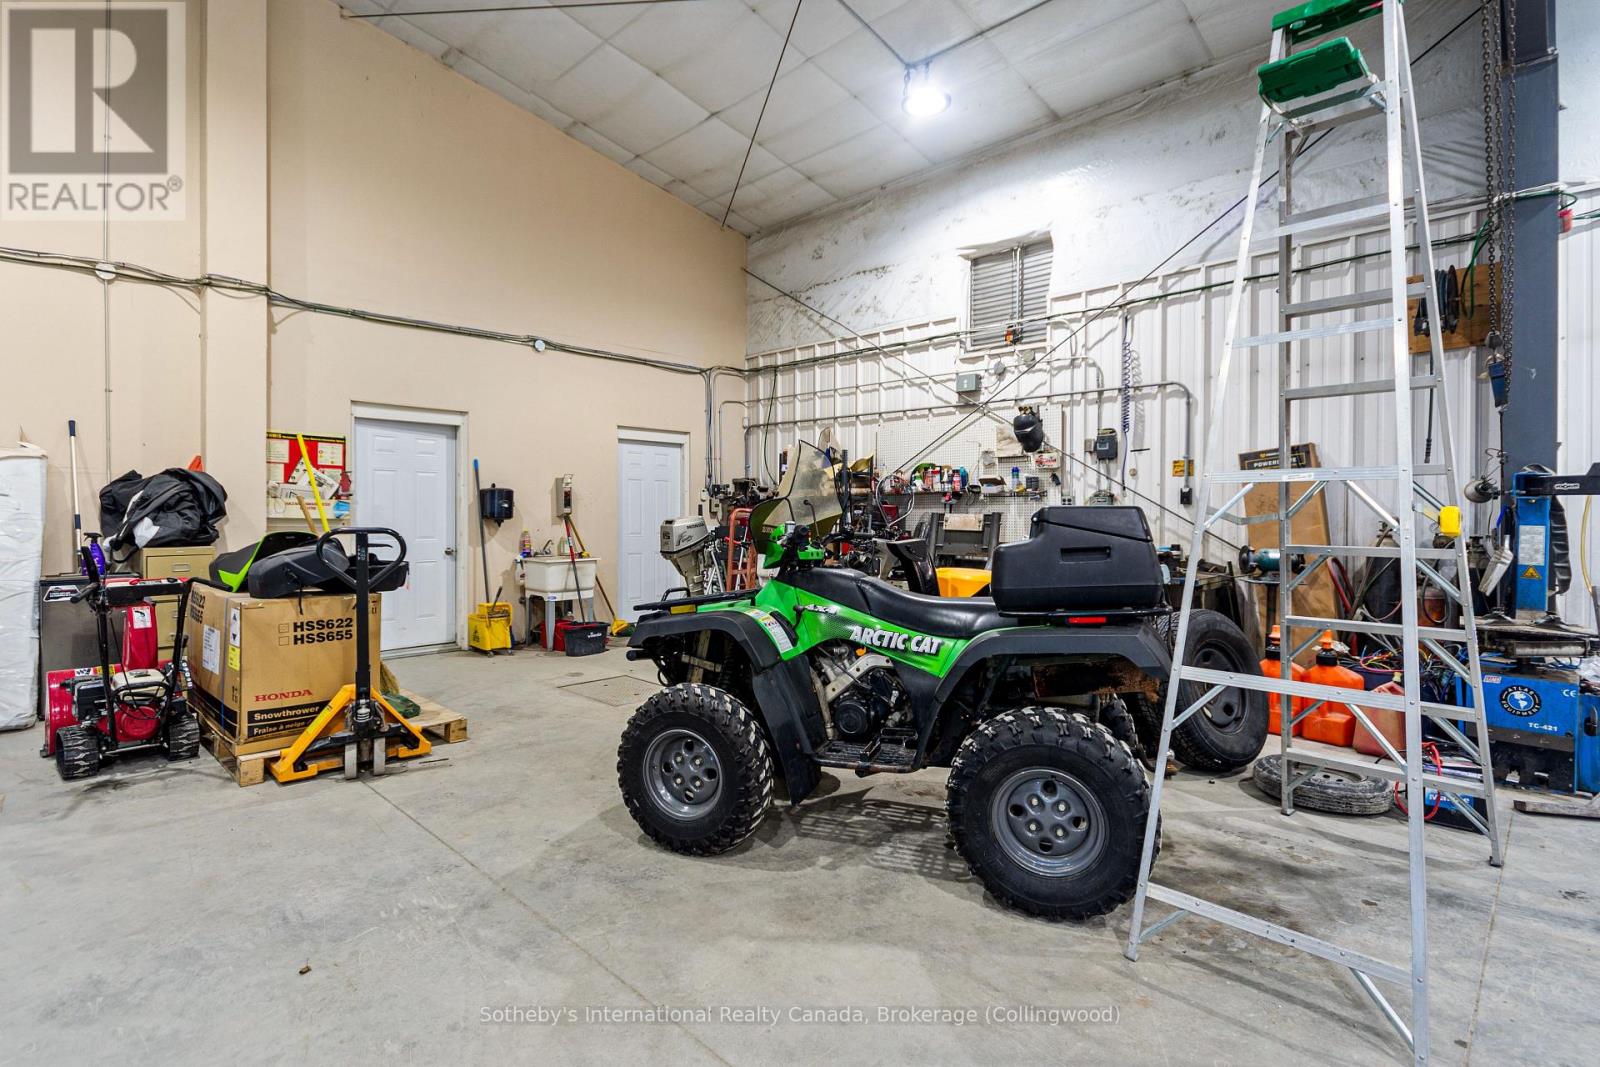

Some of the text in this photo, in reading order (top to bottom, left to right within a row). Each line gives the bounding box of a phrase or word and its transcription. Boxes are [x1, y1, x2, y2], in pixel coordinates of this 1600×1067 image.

[293, 618, 353, 633] HSS622
[293, 630, 353, 645] HSS655
[850, 626, 943, 655] ARCTIC CAT
[254, 689, 313, 702] HONDA
[1507, 686, 1535, 695] ATLAS
[1562, 689, 1576, 698] CE
[254, 705, 320, 721] Snowthrower
[1501, 700, 1541, 716] EQUIPMENT
[1528, 722, 1558, 732] TC-421
